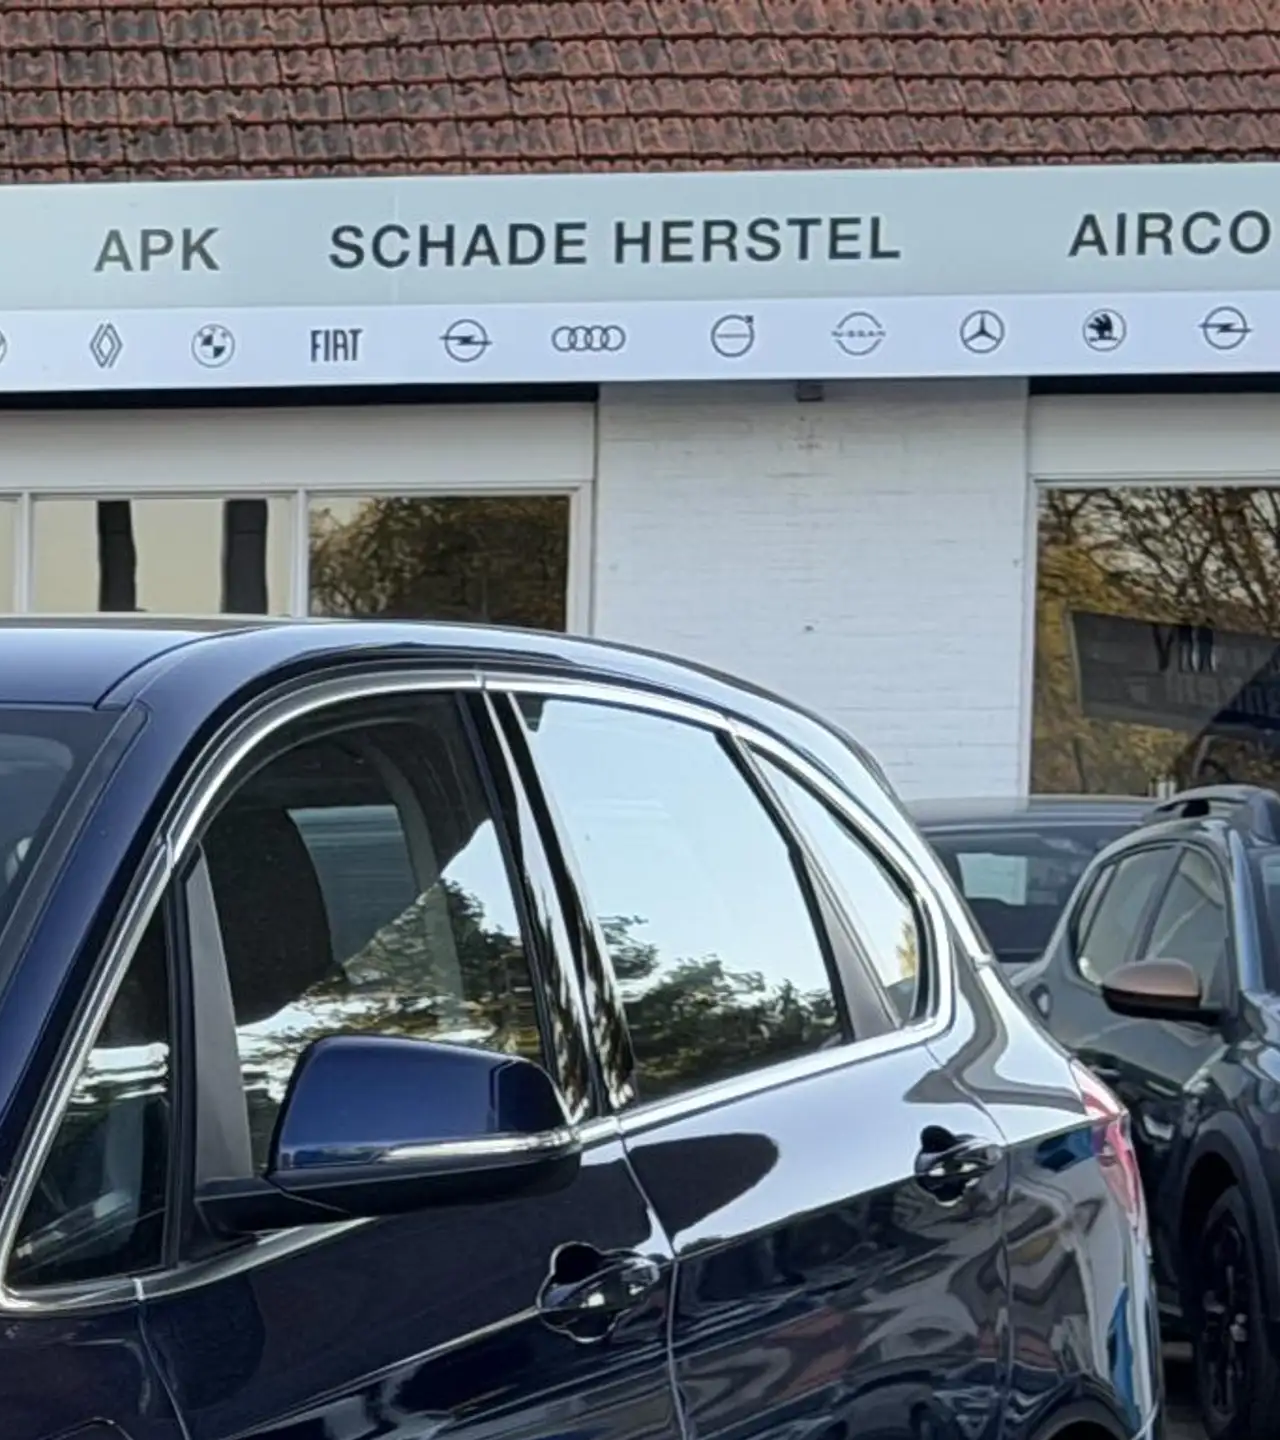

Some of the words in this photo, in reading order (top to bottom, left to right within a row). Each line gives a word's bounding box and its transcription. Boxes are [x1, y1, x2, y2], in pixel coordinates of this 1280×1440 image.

[94, 227, 220, 271] APK
[329, 222, 587, 269] SCHADE
[614, 217, 901, 263] HERSTEL
[1067, 210, 1271, 256] AIRCO
[310, 329, 363, 362] FIAT
